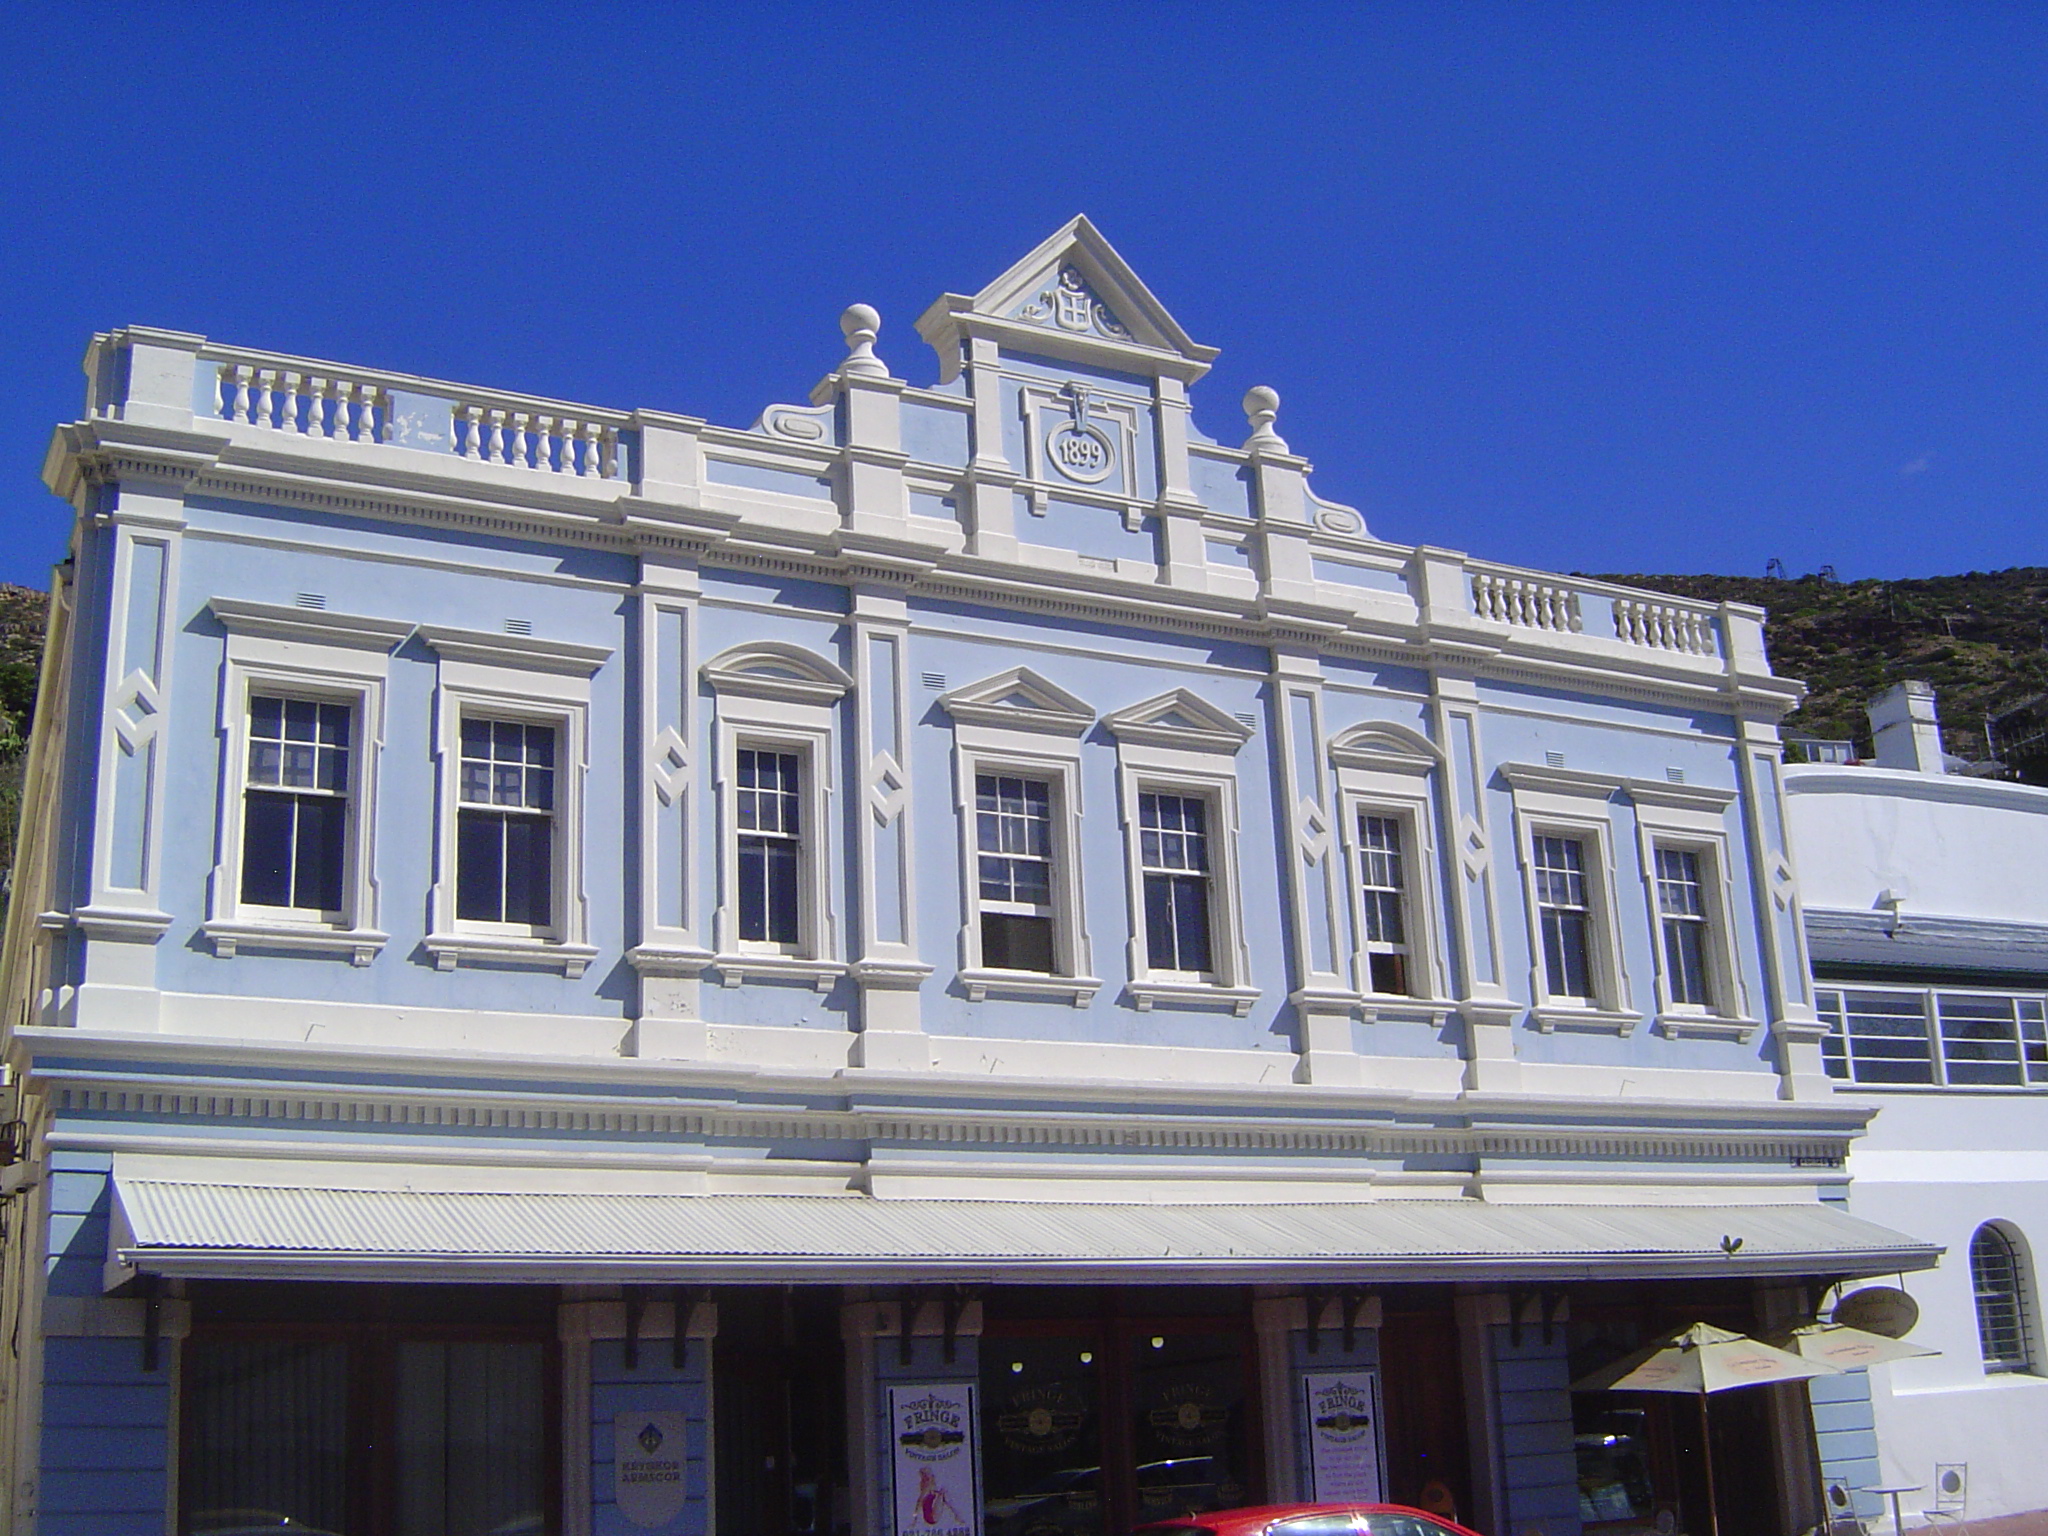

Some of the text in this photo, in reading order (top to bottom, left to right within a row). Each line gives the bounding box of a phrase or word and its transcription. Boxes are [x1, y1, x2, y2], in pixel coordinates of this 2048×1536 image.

[1059, 437, 1102, 469] 1899
[1011, 1388, 1064, 1407] FRINGE
[1318, 1395, 1366, 1414] FRINGE
[903, 1410, 961, 1429] FRINGE
[905, 1446, 960, 1461] VINTAGE SALON
[622, 1472, 681, 1483] ARMSCOR
